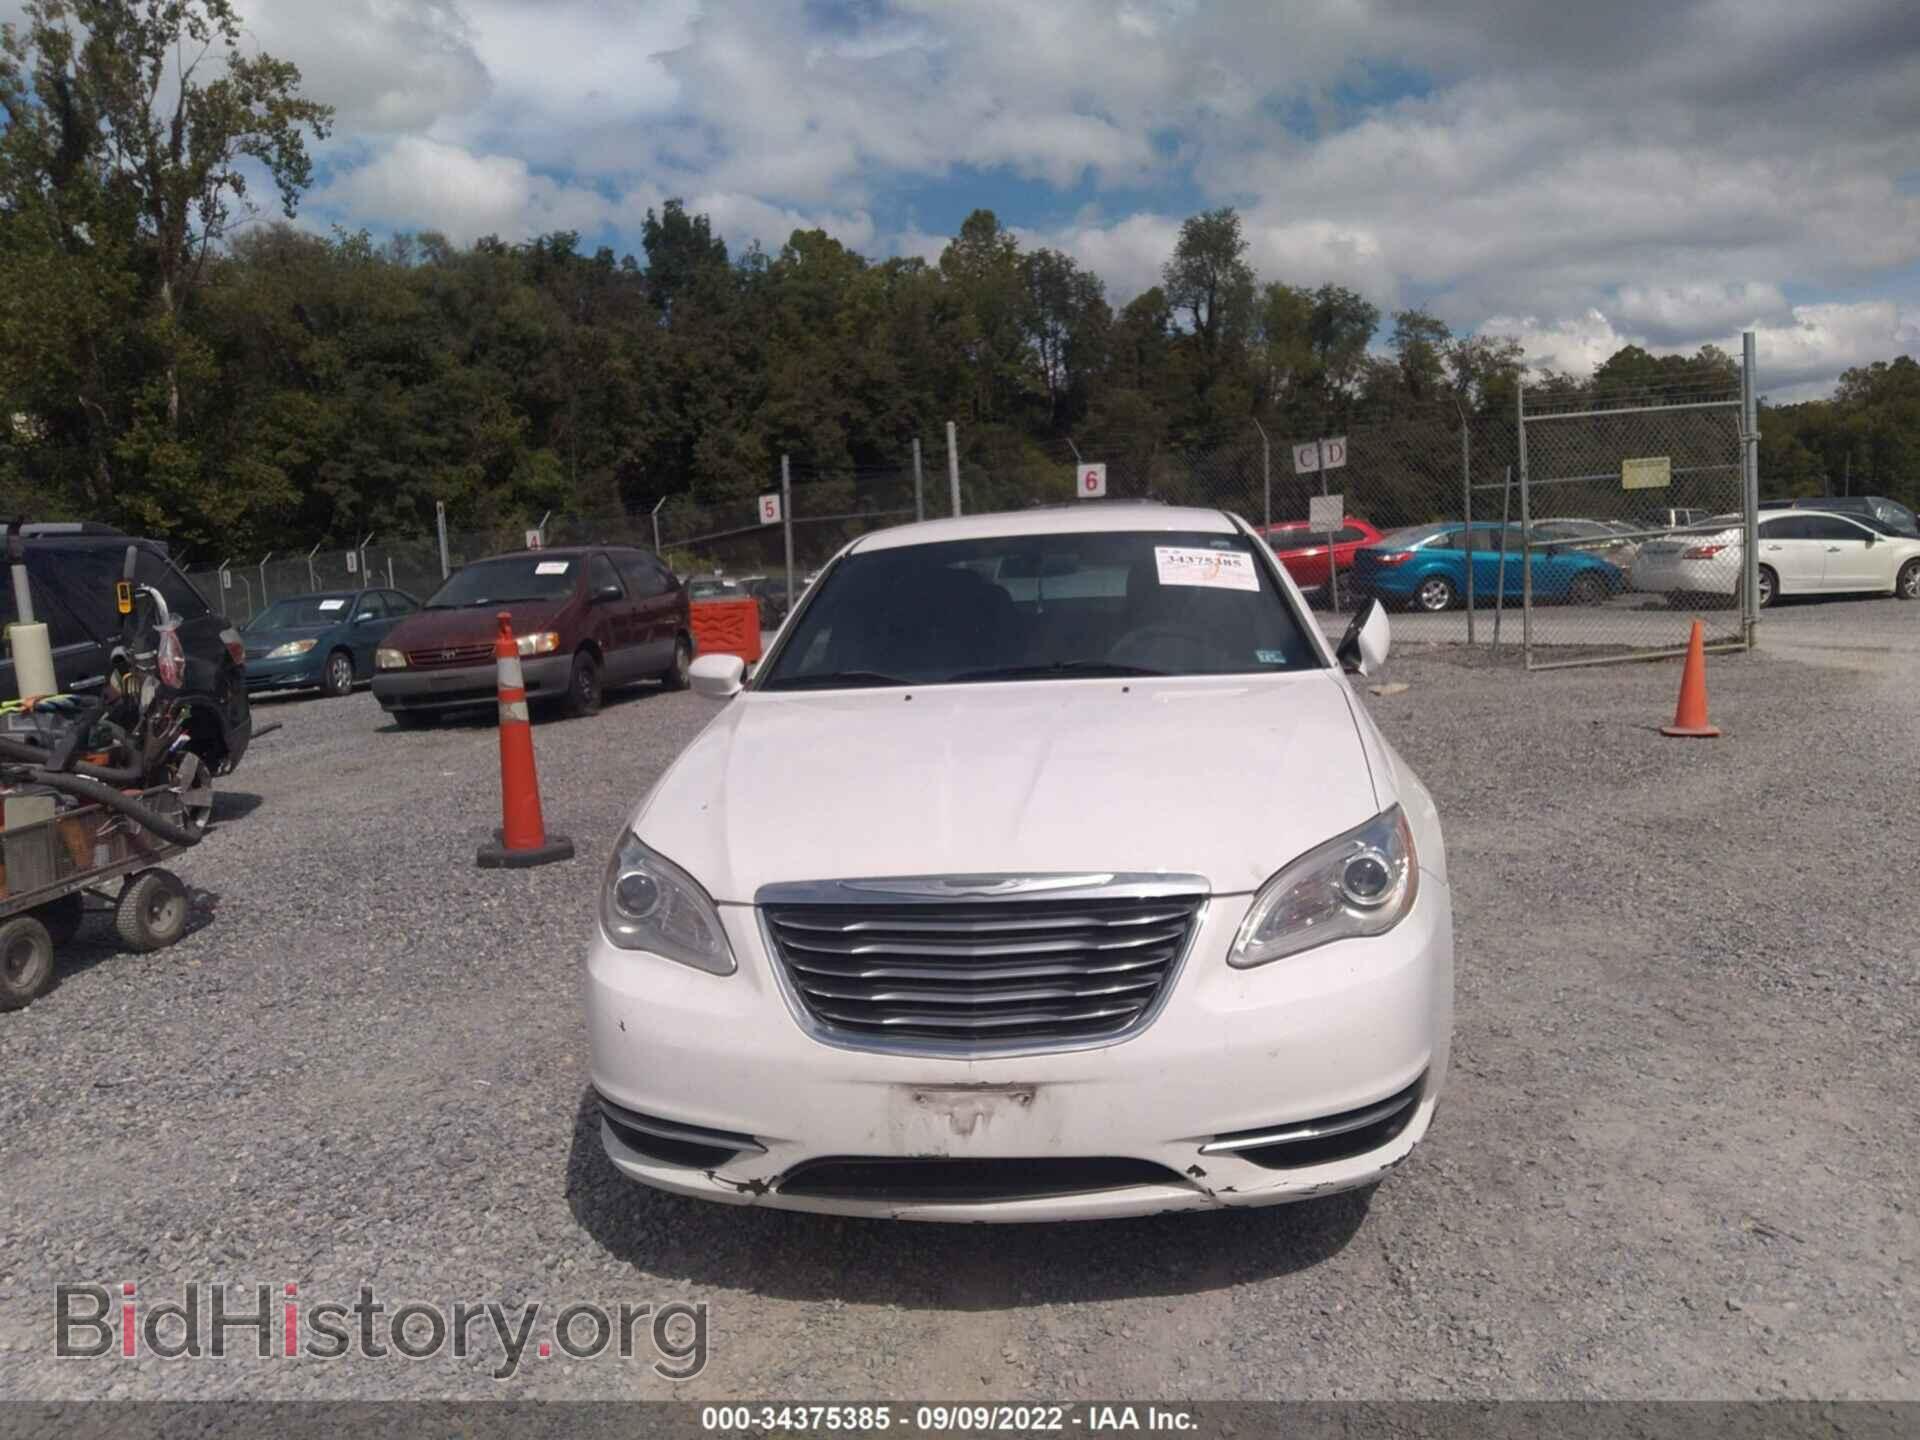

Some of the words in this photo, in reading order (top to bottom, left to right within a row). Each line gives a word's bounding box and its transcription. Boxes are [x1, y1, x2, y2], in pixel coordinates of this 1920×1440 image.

[1300, 448, 1315, 468] C
[1328, 443, 1344, 464] D
[1085, 470, 1098, 491] 6
[765, 501, 775, 518] 5
